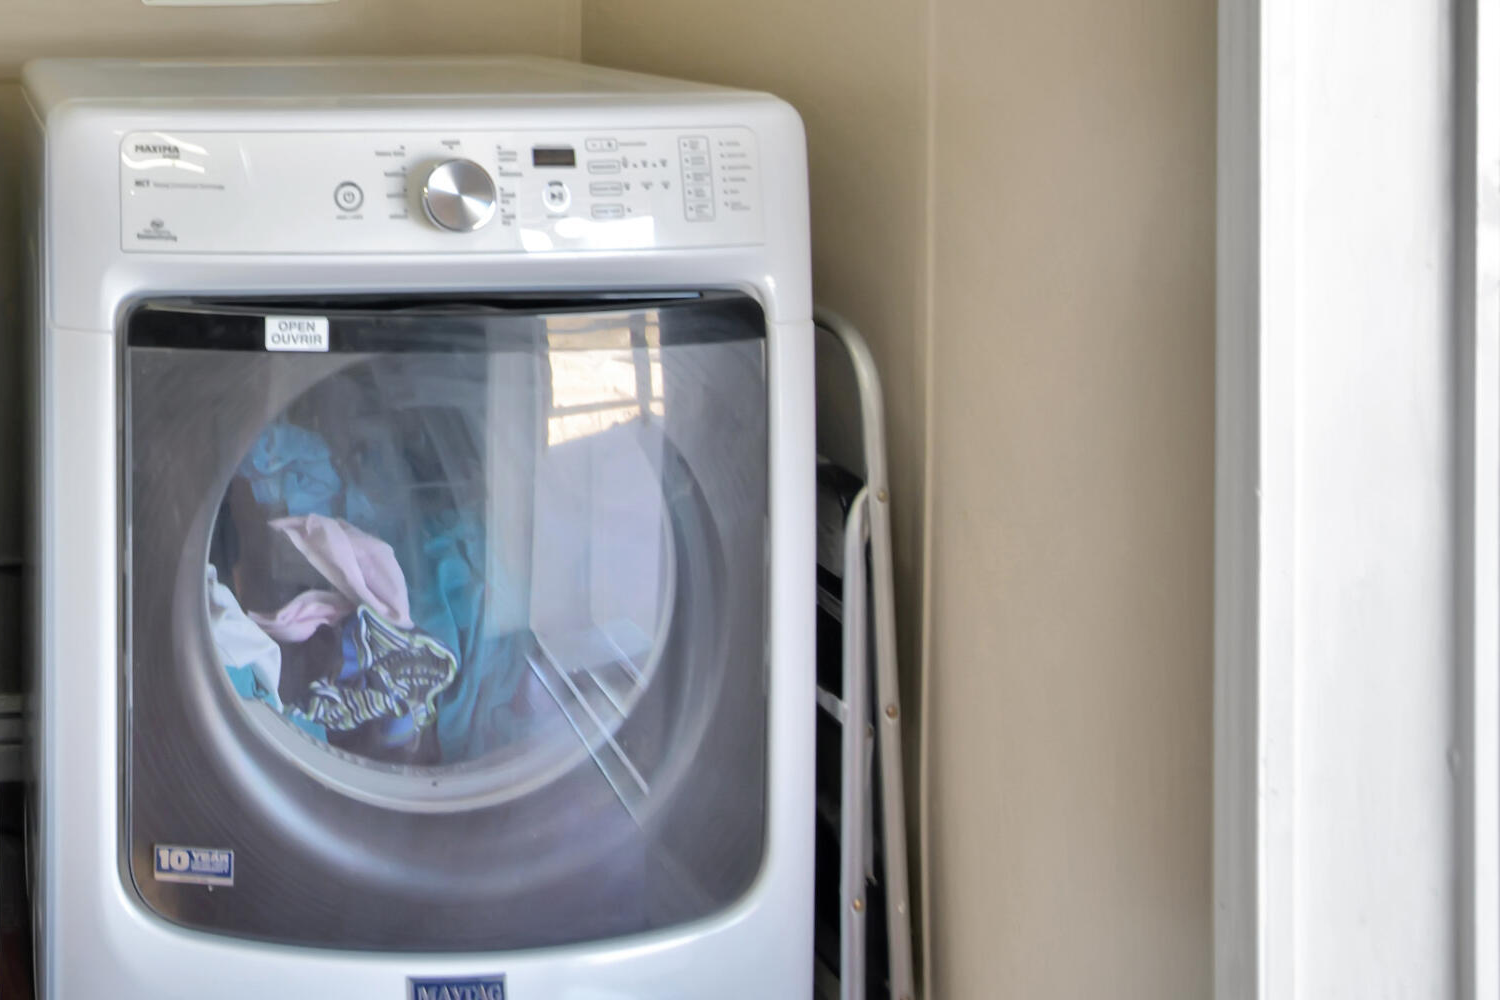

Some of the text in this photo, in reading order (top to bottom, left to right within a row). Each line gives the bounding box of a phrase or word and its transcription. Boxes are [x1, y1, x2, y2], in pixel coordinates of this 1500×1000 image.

[134, 144, 180, 154] MAXIMA
[278, 321, 316, 332] OPEN
[271, 333, 323, 345] OUVRIR
[159, 849, 190, 872] 10
